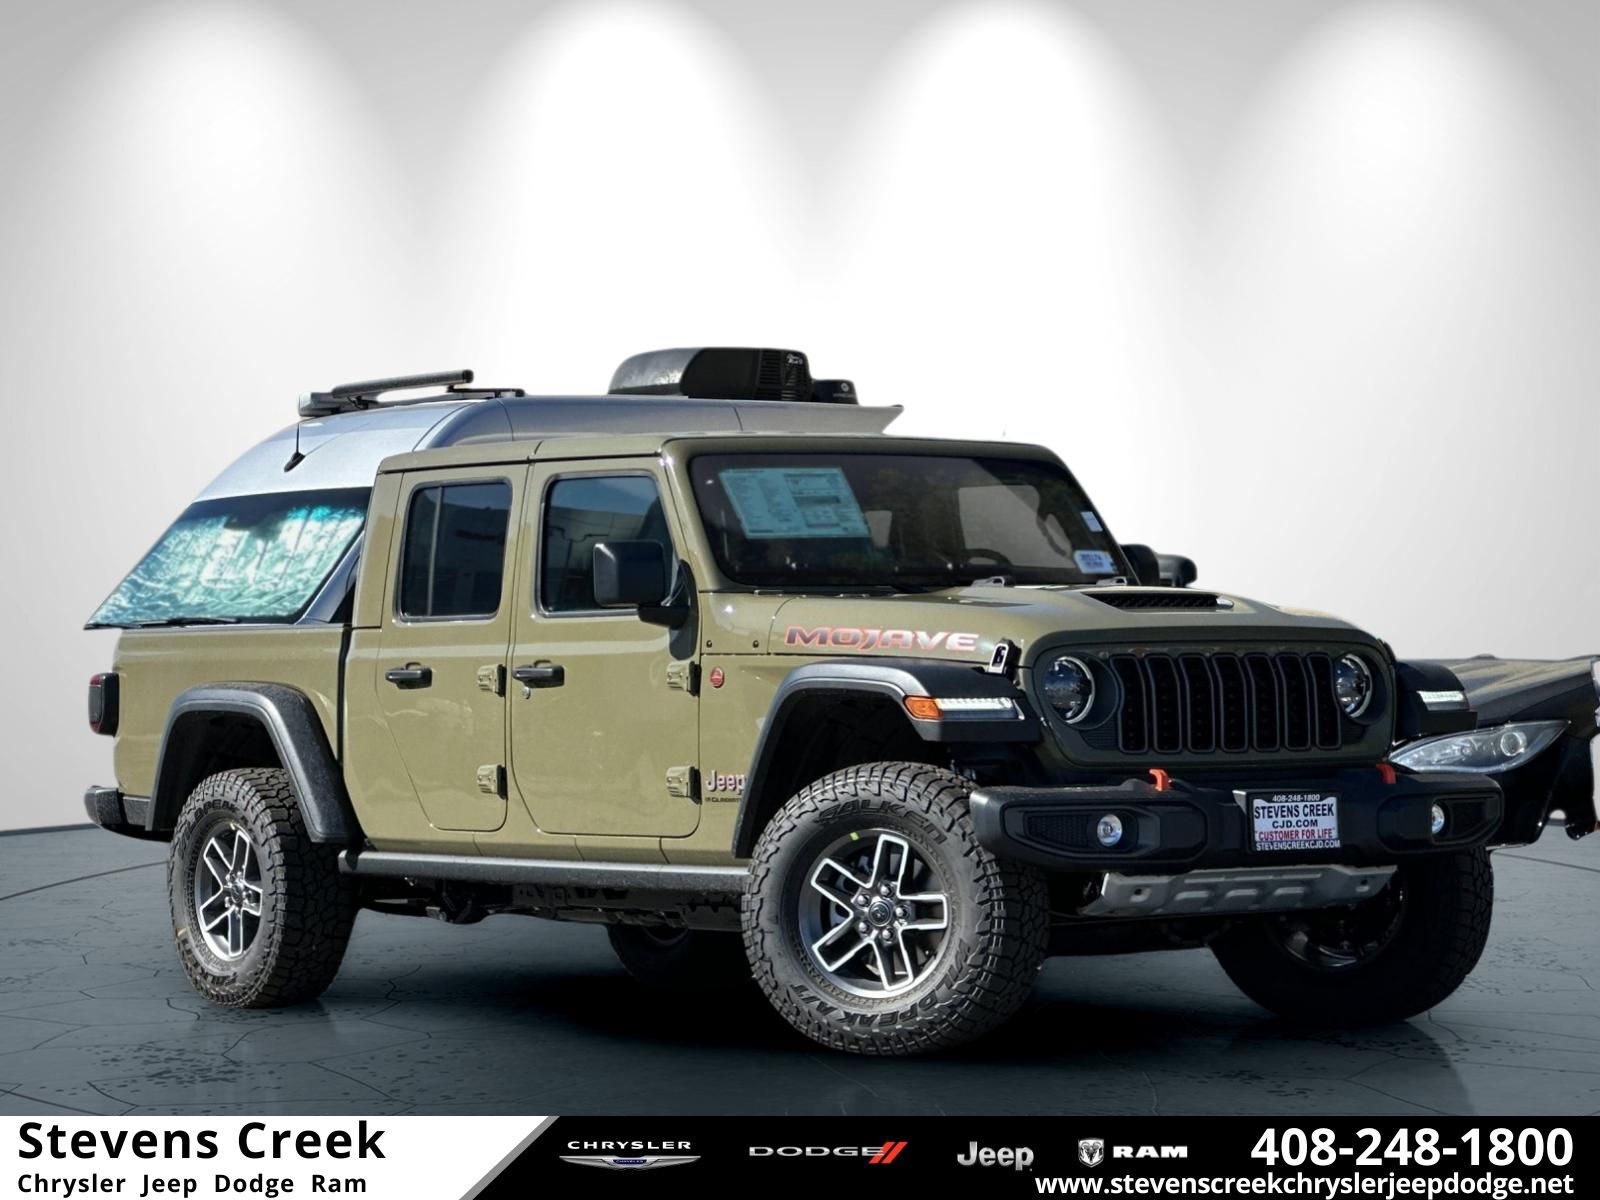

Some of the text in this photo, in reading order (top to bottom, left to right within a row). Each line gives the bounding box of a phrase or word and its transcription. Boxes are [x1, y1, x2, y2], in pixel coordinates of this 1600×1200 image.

[785, 626, 979, 651] MOJAVE
[705, 770, 746, 795] Jeep
[1272, 794, 1320, 802] 408-248-1800
[1254, 803, 1334, 819] STEVENS CREEK
[813, 799, 948, 845] FALKEN
[1272, 819, 1318, 829] CJD.COM
[1301, 829, 1315, 839] FOR
[1255, 840, 1341, 851] STEVENSCREEKCJD.COM
